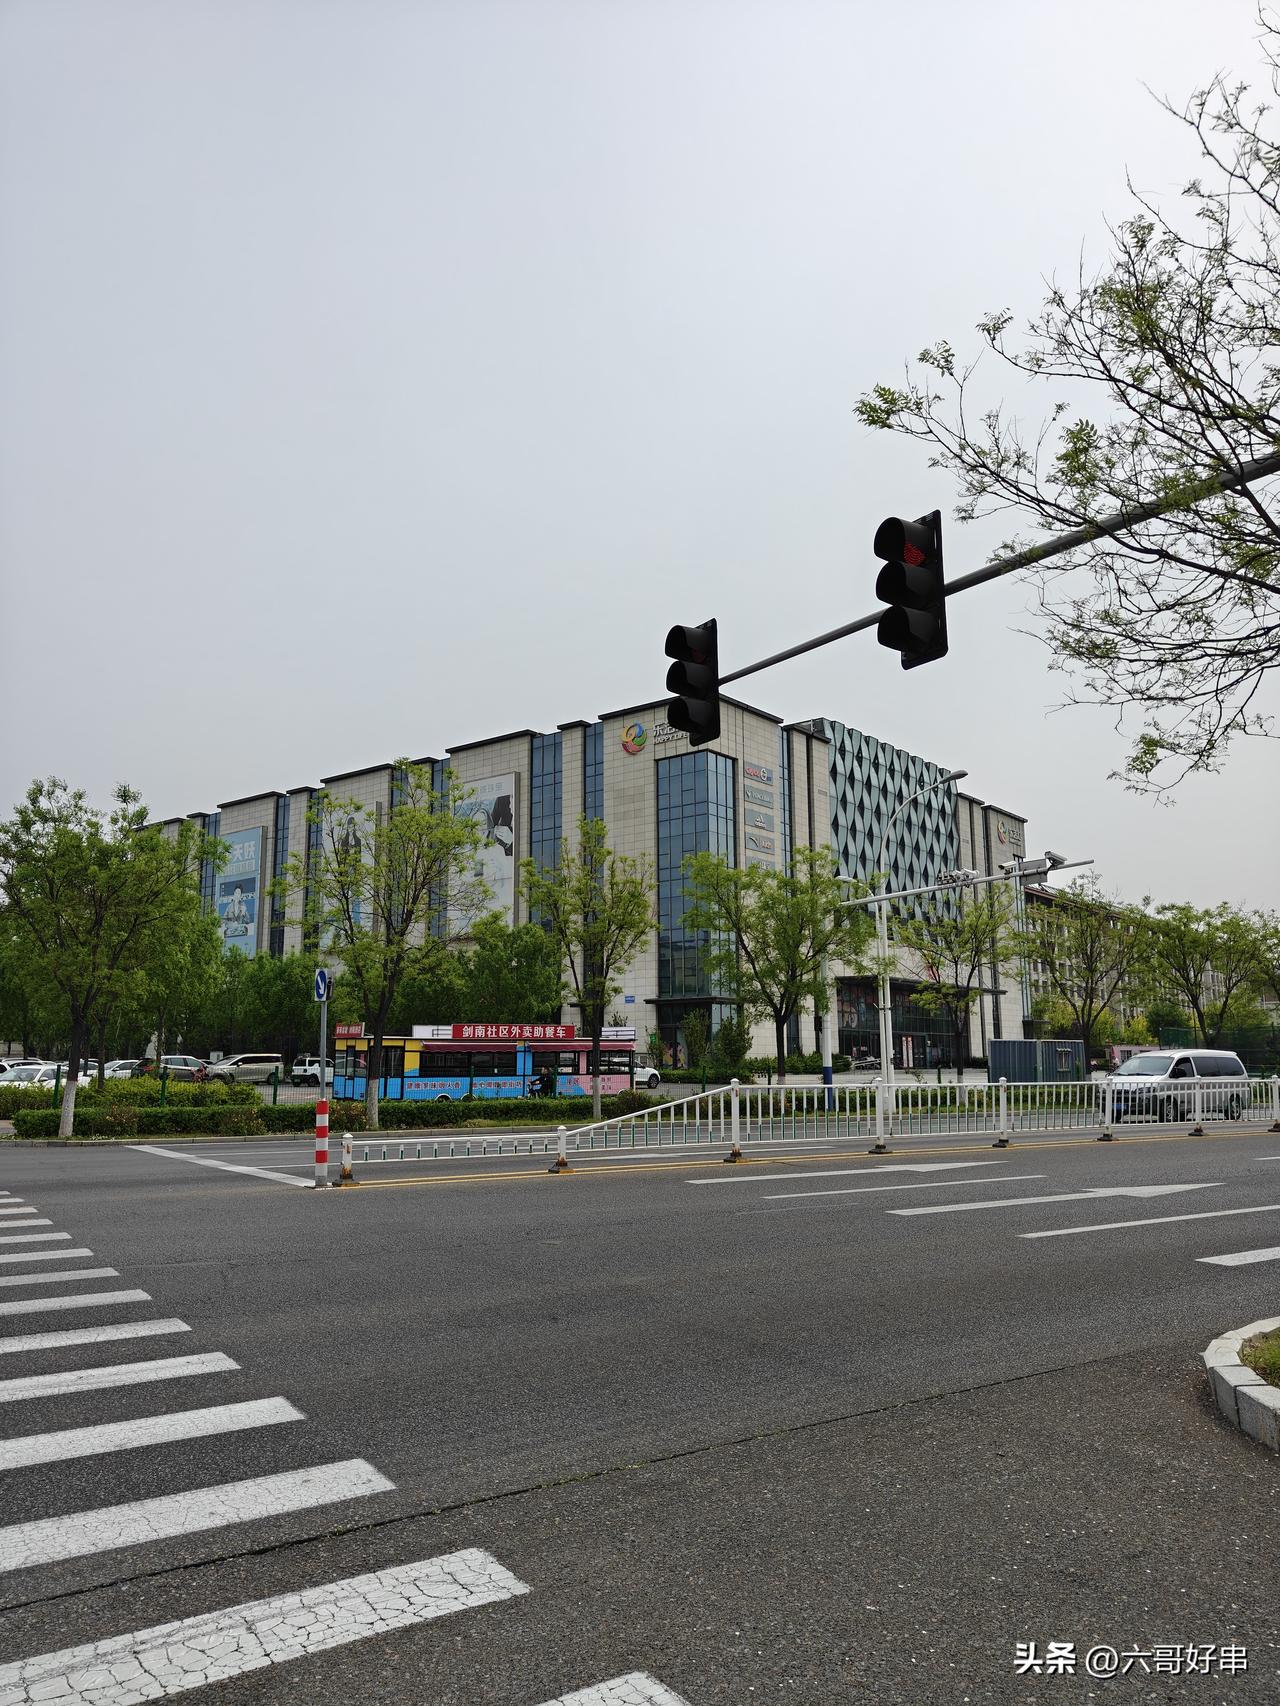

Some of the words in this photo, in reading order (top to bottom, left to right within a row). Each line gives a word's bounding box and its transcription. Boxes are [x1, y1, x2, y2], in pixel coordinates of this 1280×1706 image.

[462, 1025, 566, 1038] 剑南社区外卖助餐车
